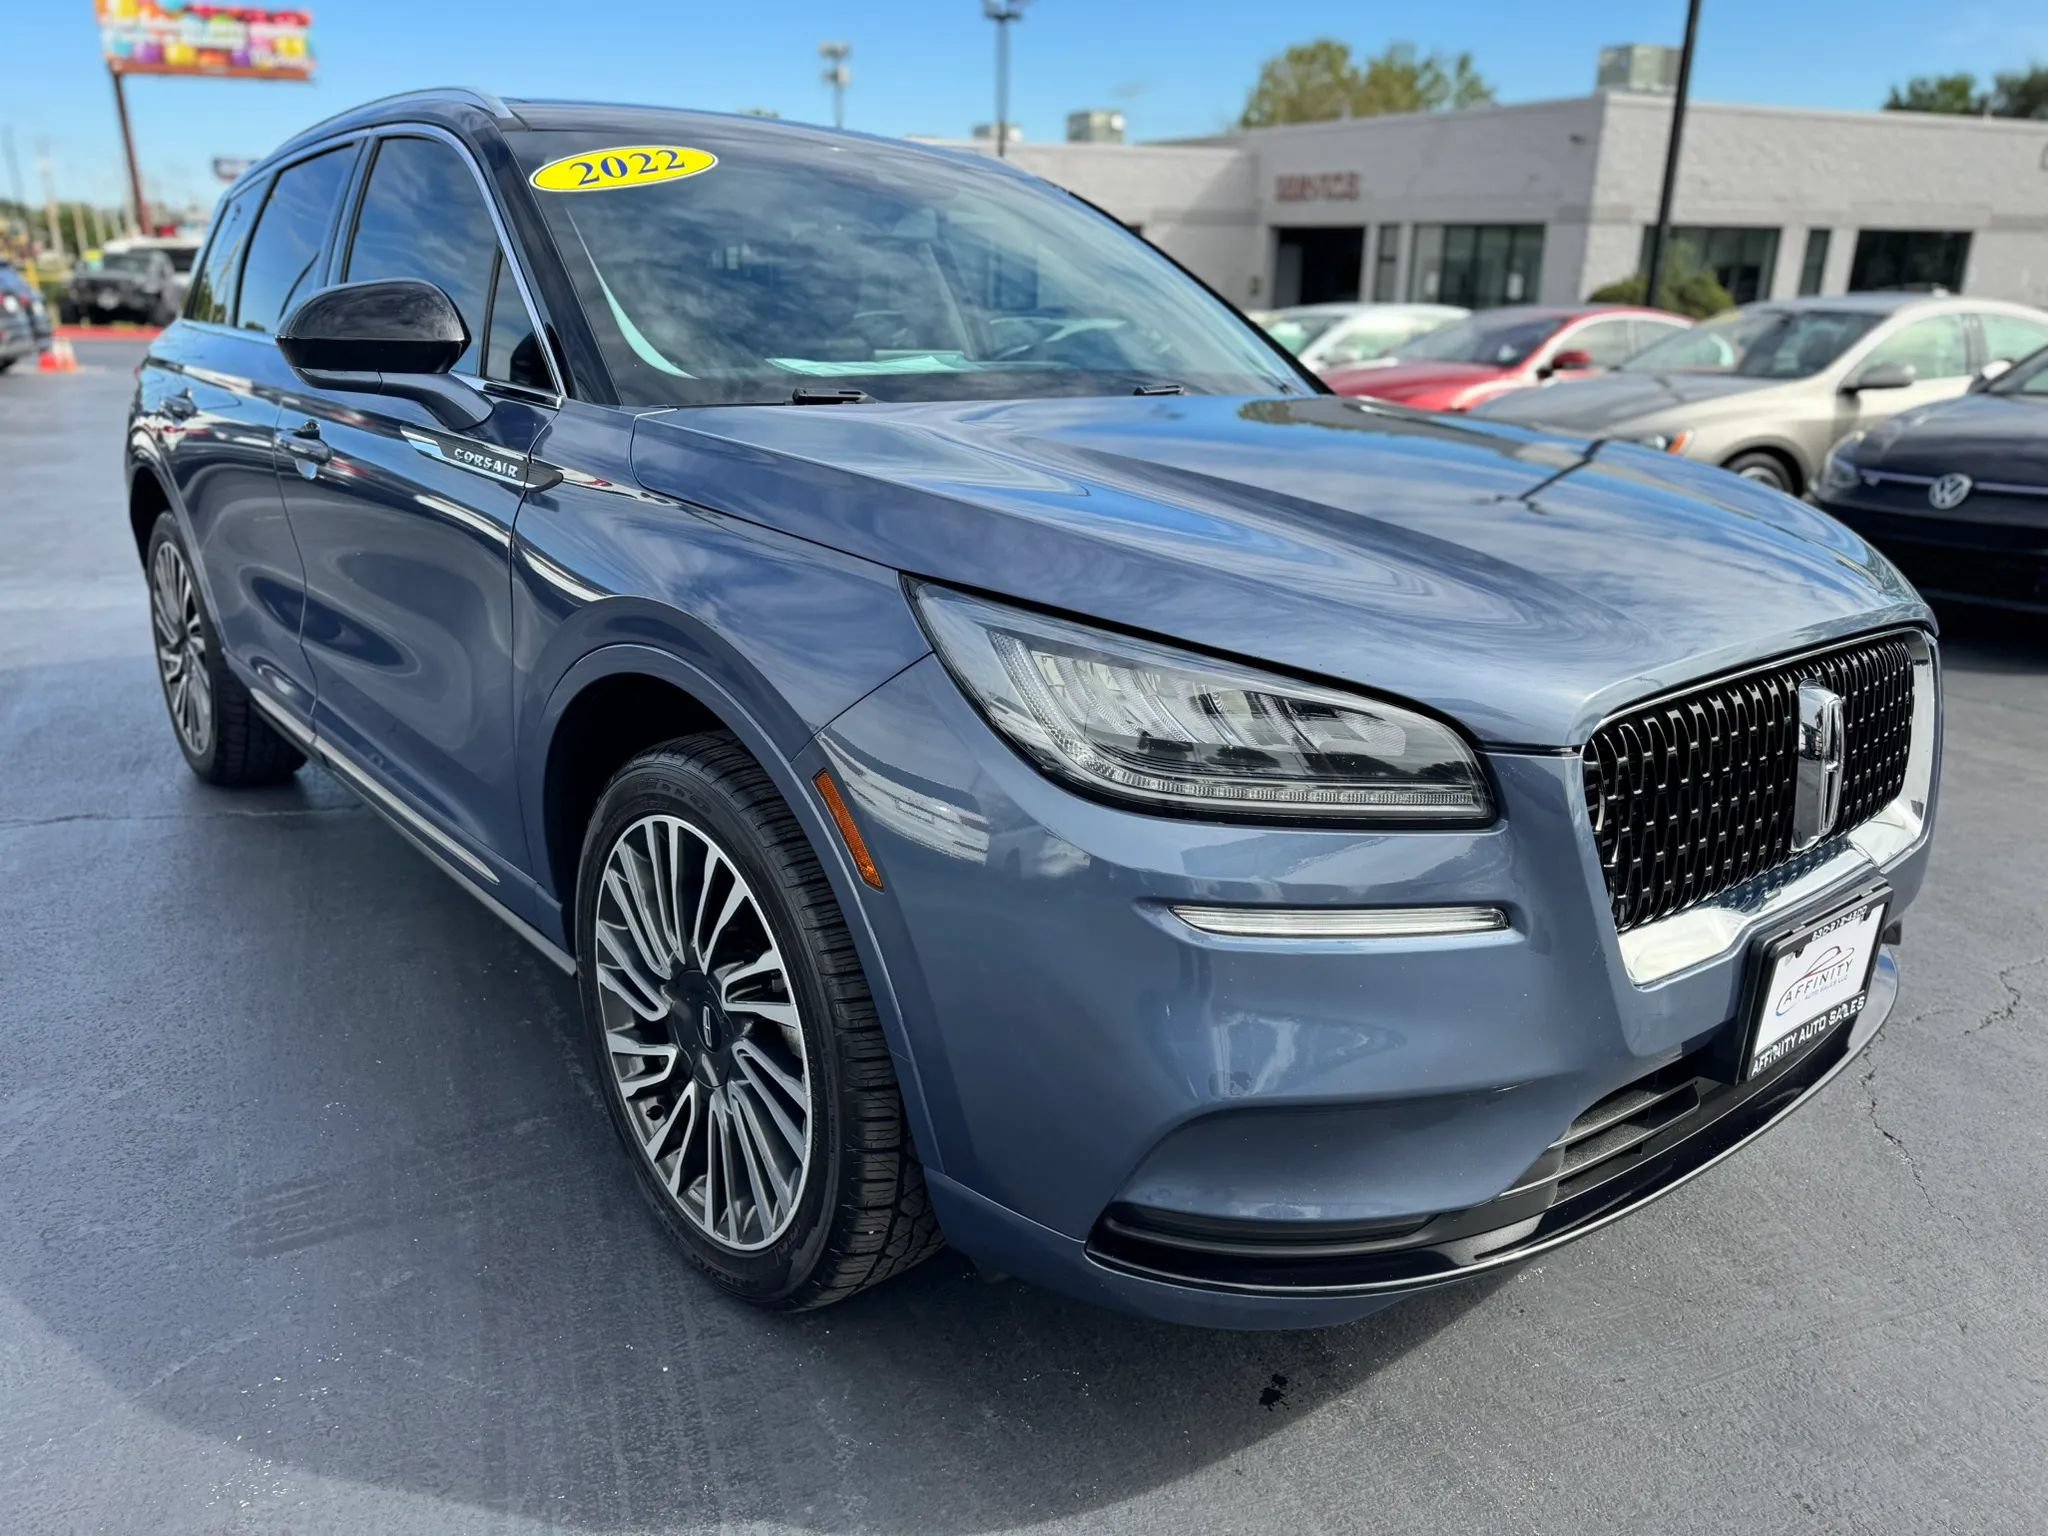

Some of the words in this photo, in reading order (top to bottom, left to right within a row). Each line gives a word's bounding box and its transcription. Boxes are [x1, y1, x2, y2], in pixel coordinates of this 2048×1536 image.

[569, 149, 686, 186] 2022
[453, 447, 519, 478] CORSAIR
[1783, 958, 1854, 1006] AFFINITY
[1750, 1032, 1798, 1077] AFFINITY
[1798, 1015, 1827, 1046] AUTO
[1828, 995, 1866, 1027] SALES
